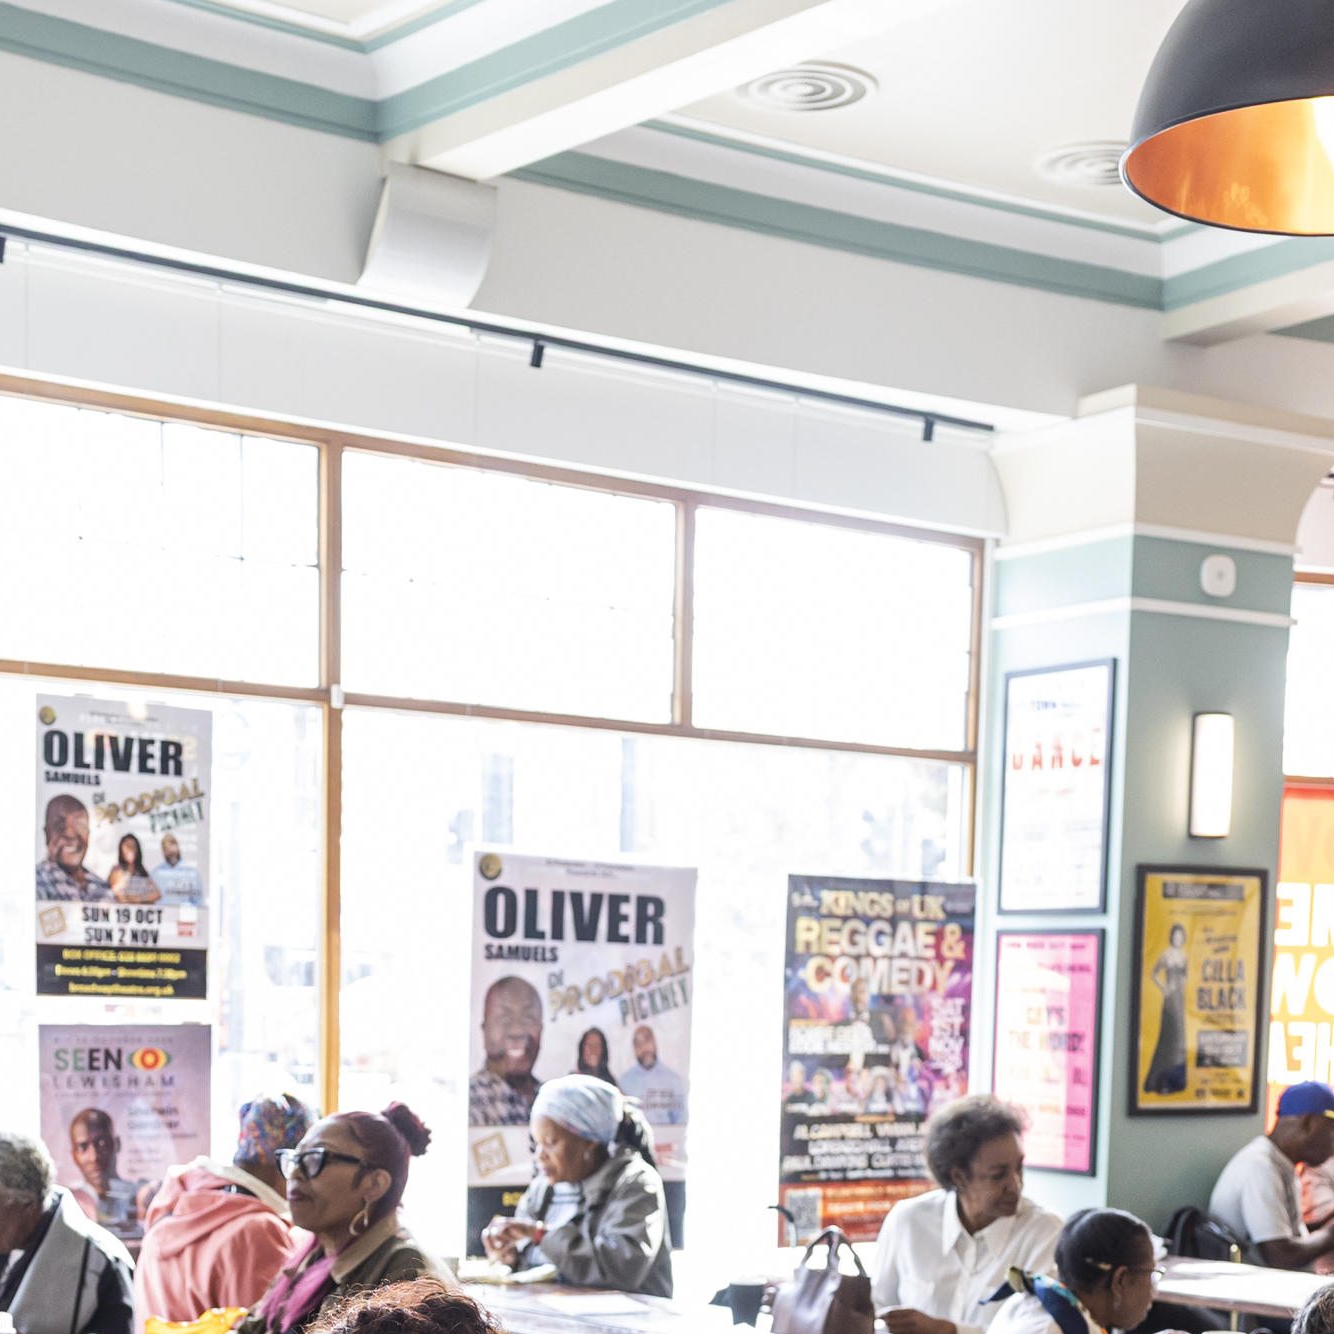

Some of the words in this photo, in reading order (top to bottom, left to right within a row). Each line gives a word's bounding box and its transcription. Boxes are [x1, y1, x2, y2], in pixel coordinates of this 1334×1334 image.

[43, 729, 183, 776] OLIVER
[44, 770, 101, 786] SAMUELS
[82, 906, 110, 922] SUN
[116, 908, 130, 923] 19
[136, 909, 162, 924] OCT
[484, 886, 665, 945] OLIVER
[819, 889, 895, 918] KINGS
[911, 894, 947, 920] UK
[85, 927, 113, 942] SUN
[118, 928, 126, 943] 2
[131, 929, 159, 944] NOV
[795, 916, 936, 959] REGGAE
[940, 922, 966, 960] &
[484, 944, 558, 963] SAMUELS
[805, 954, 955, 996] COMEDY
[1196, 986, 1246, 1012] BLACK
[54, 1048, 122, 1071] SEEN
[53, 1073, 175, 1089] LEWISHAM
